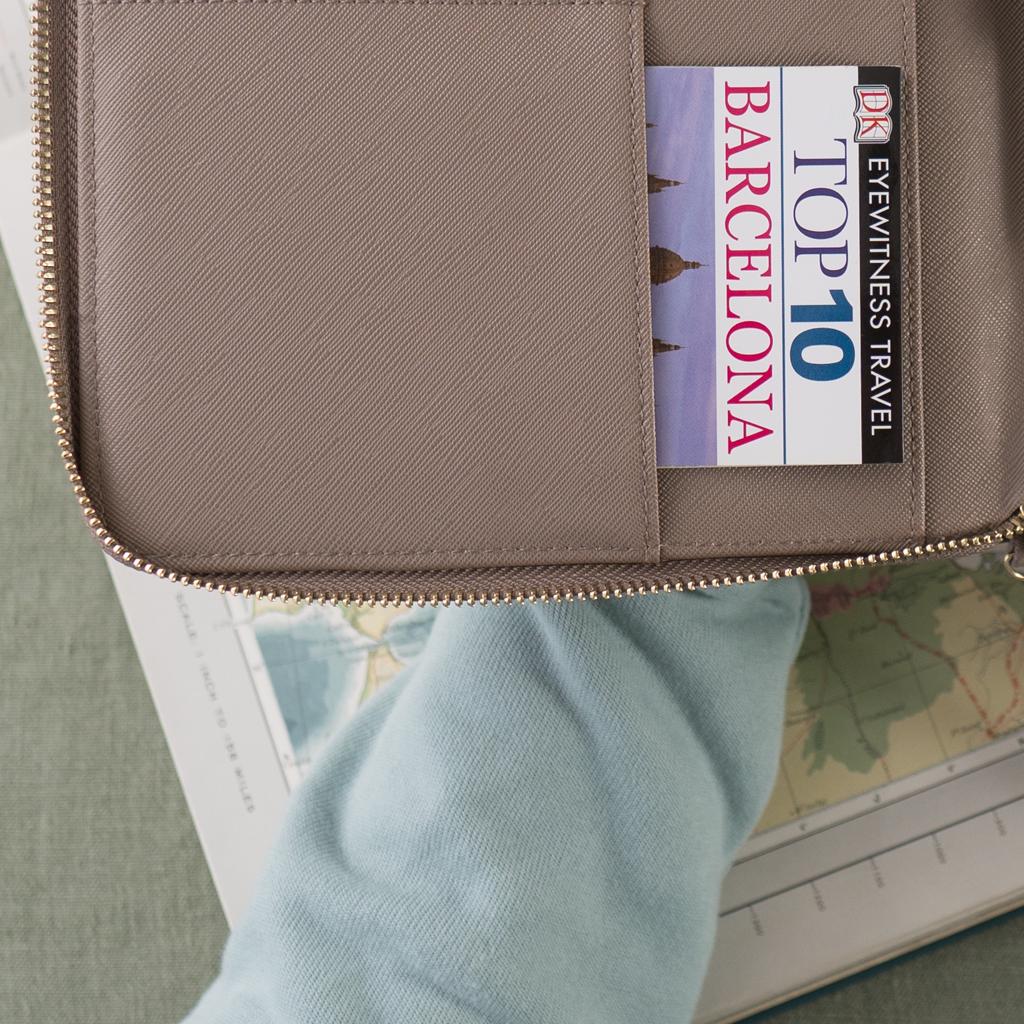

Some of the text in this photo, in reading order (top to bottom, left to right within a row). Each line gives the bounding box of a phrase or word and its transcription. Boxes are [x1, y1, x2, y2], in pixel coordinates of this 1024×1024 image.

[859, 90, 890, 141] DK
[724, 81, 774, 455] BARCELONA
[789, 138, 856, 382] TOP 10
[868, 157, 893, 436] EYEWITNESS TRAVEL
